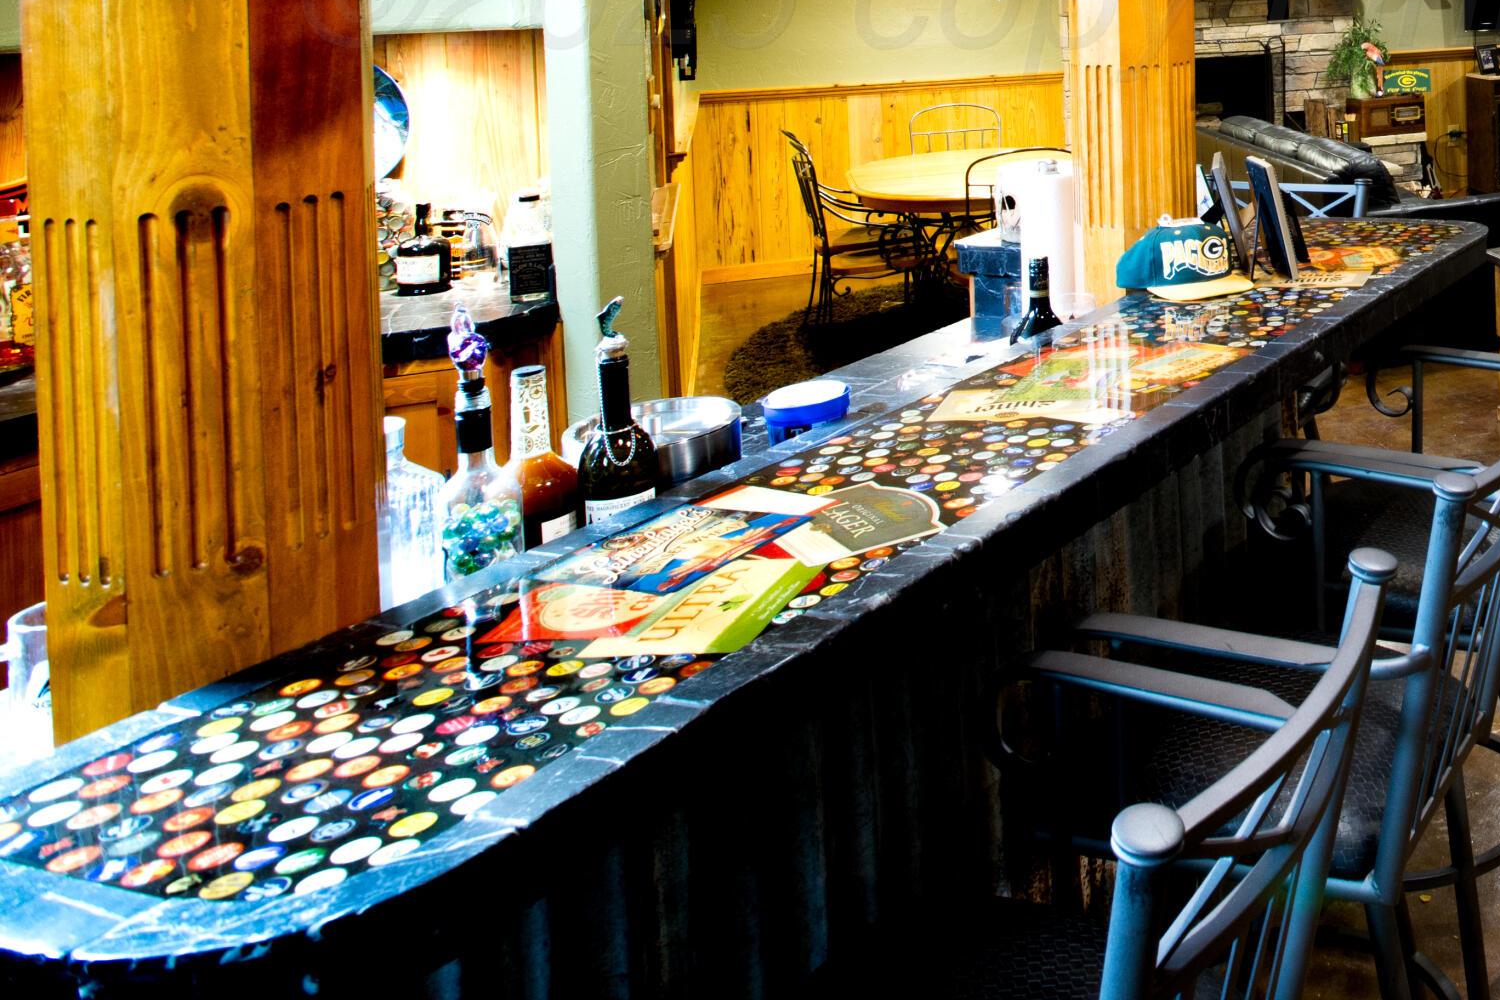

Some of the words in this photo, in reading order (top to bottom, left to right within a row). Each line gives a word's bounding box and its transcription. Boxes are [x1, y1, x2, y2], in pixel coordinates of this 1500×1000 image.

[596, 500, 631, 512] MAGNIFICENT
[820, 500, 877, 539] LAGER
[851, 504, 885, 525] ORIGINAL
[637, 565, 750, 643] ULTRA
